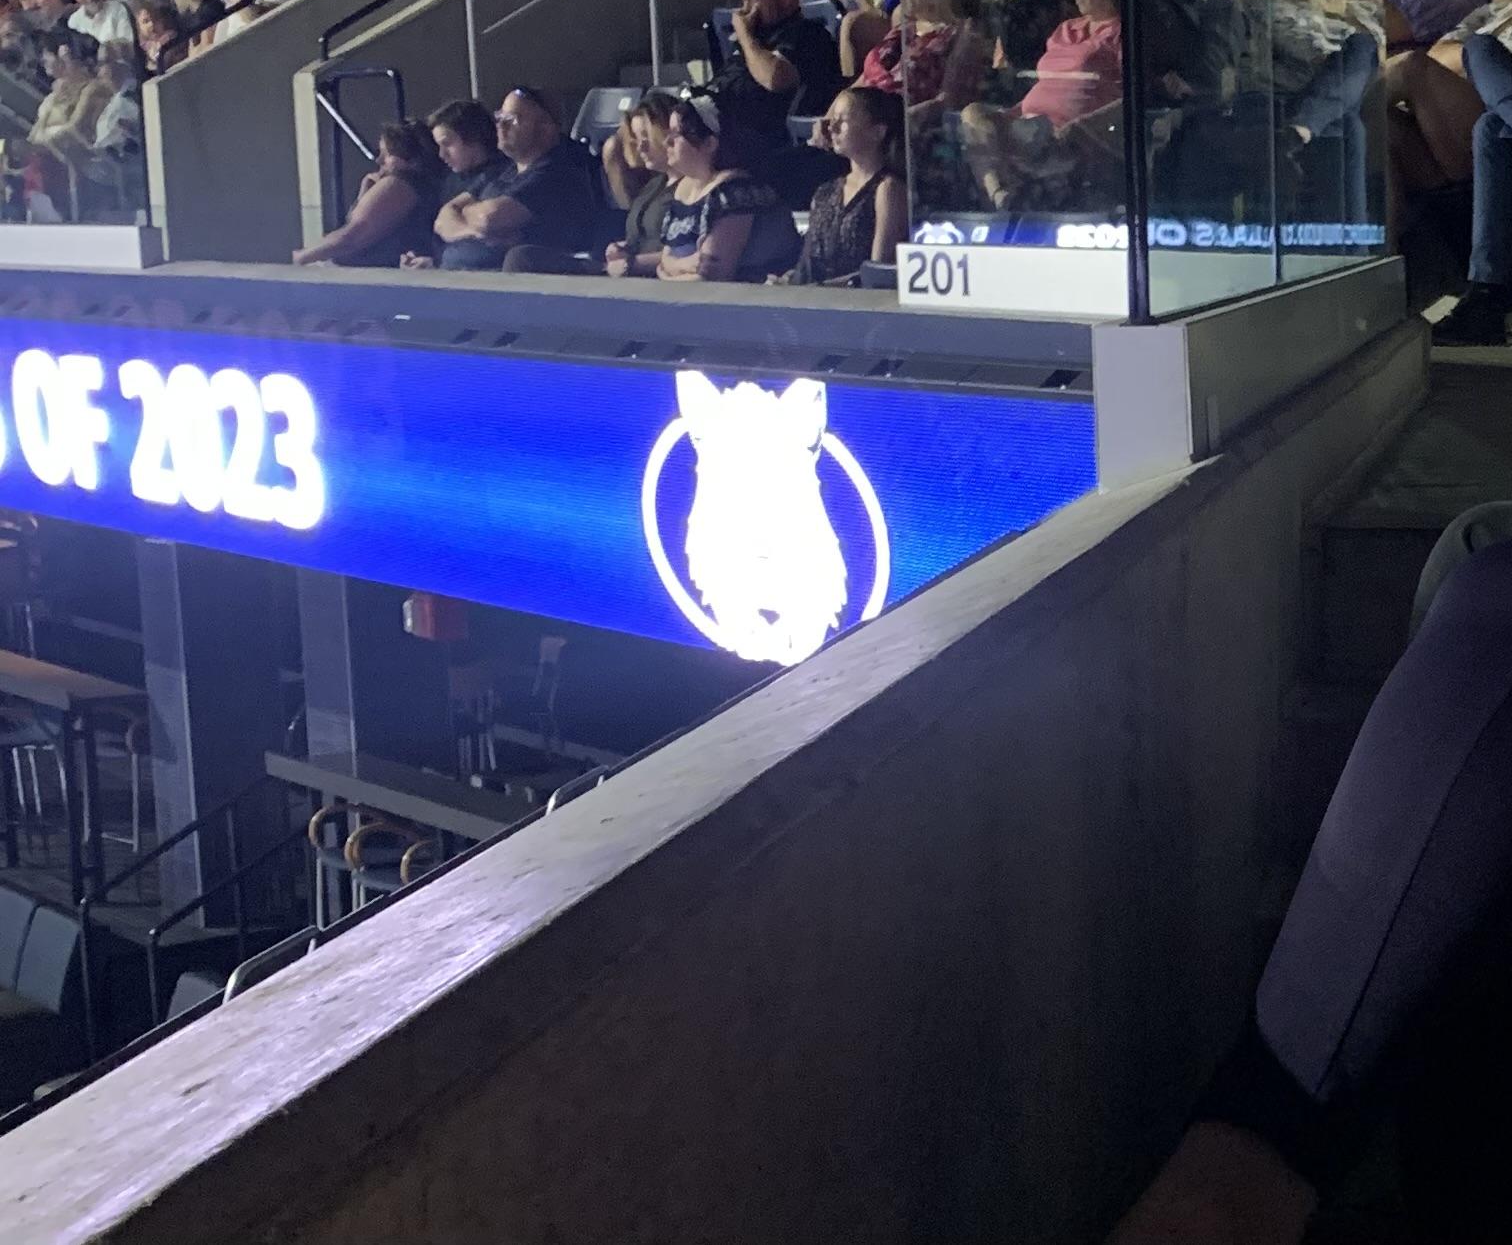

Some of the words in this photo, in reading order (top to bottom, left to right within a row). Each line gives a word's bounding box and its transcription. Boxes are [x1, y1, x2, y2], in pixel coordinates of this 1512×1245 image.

[907, 251, 969, 297] 201
[11, 348, 110, 491] OF
[117, 358, 325, 530] 2023
